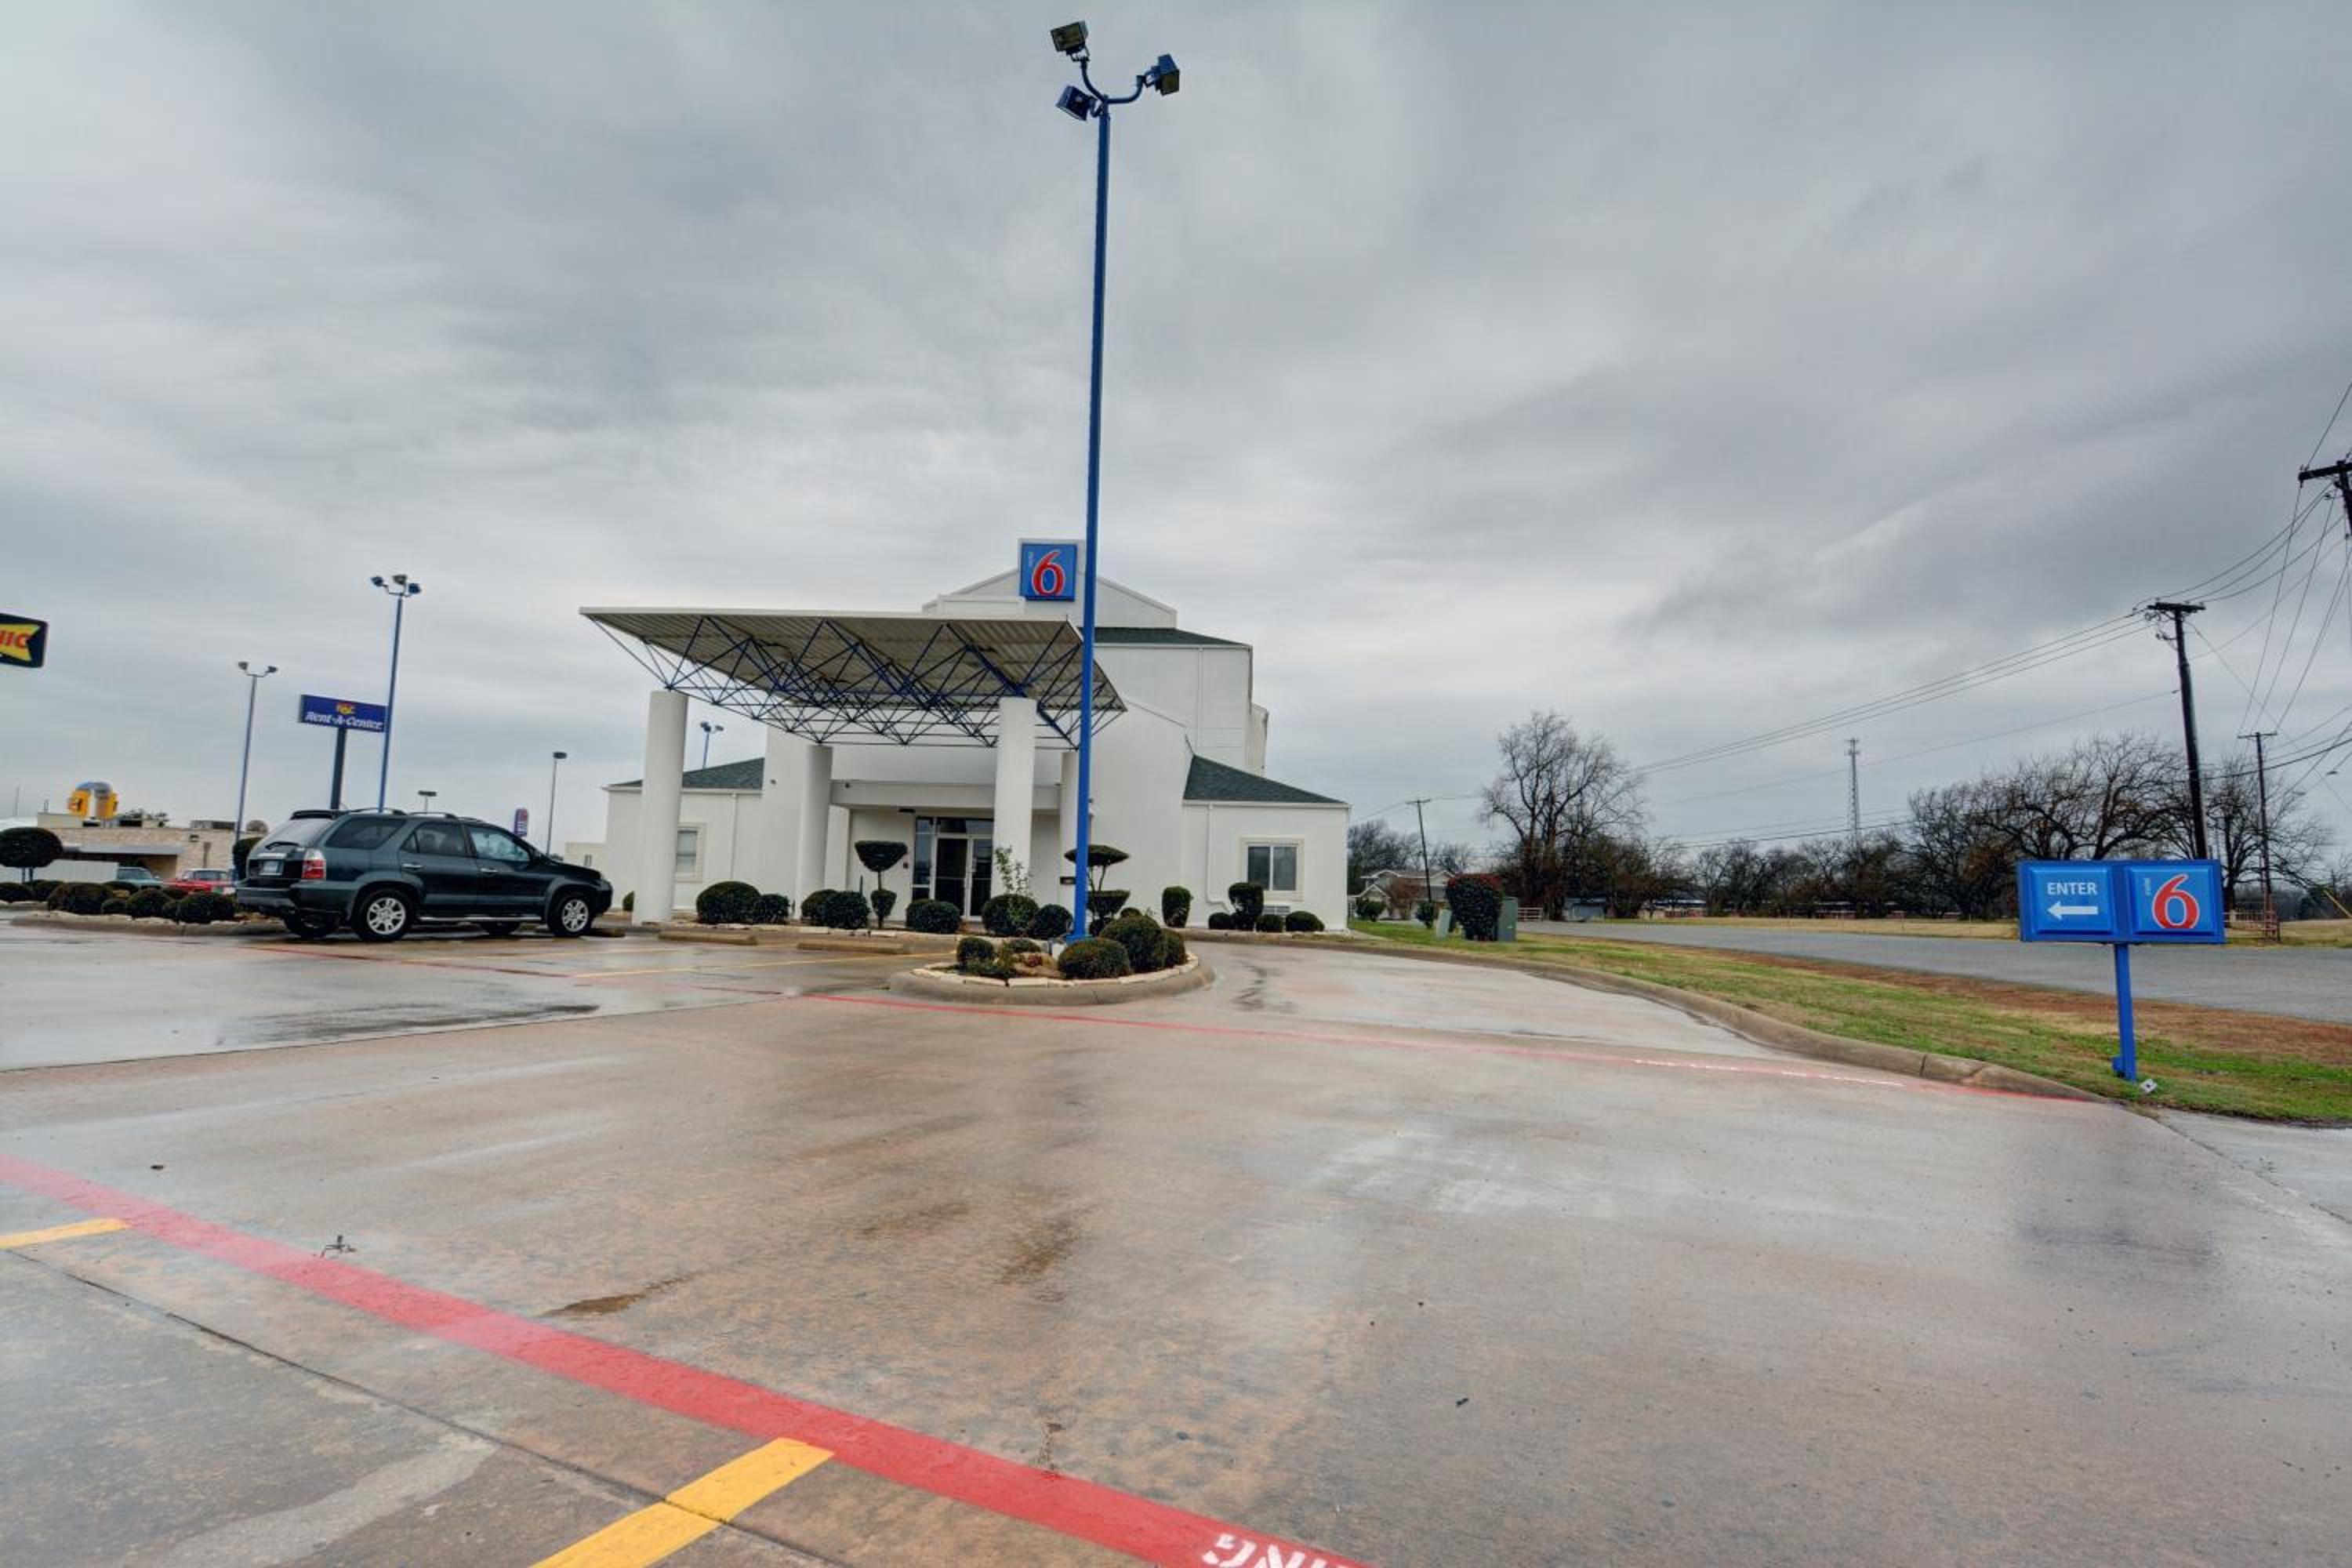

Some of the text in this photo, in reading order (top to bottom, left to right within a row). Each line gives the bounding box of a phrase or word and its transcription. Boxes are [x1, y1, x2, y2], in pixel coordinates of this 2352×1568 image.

[1032, 550, 1065, 597] 6
[2047, 882, 2098, 895] ENTER
[2152, 873, 2200, 929] 6
